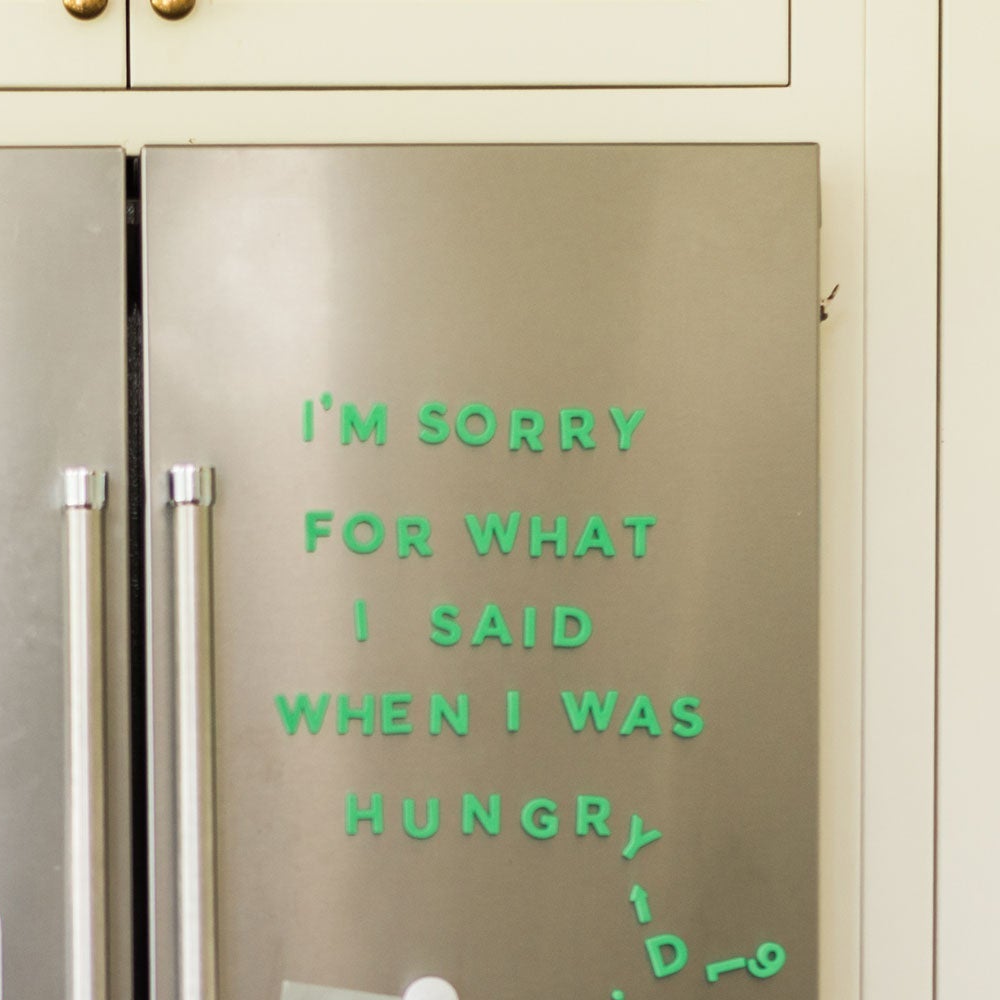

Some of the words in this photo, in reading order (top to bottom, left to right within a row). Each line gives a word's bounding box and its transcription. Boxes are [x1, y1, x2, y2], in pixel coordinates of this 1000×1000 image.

[304, 391, 387, 444] I'M
[419, 402, 645, 452] SORRY
[306, 512, 433, 558] FOR
[465, 512, 657, 558] WHAT
[355, 600, 368, 641] I
[430, 604, 593, 648] SAID
[275, 693, 470, 736] WHEN
[506, 690, 521, 733] I
[561, 690, 705, 739] WAS
[346, 793, 663, 860] HUNGRY
